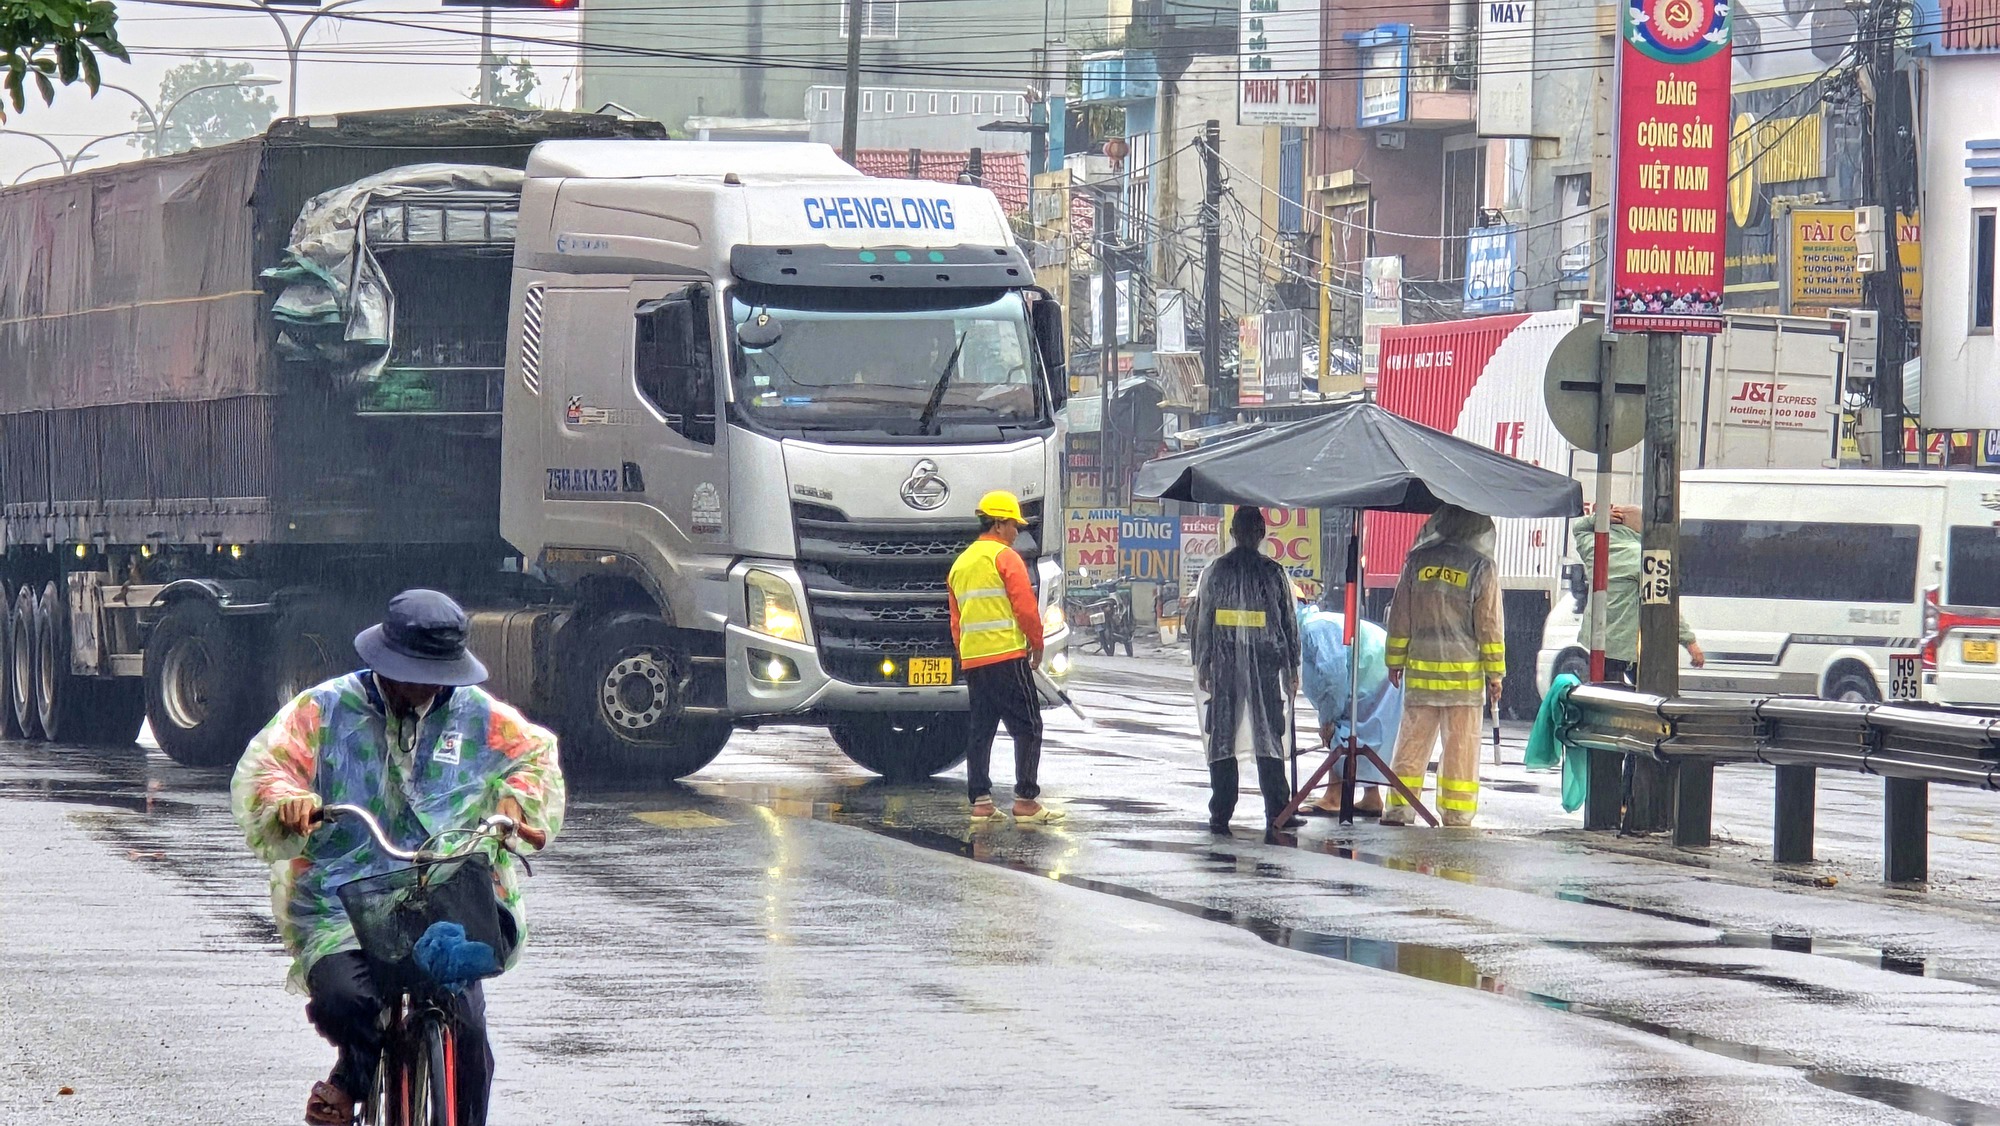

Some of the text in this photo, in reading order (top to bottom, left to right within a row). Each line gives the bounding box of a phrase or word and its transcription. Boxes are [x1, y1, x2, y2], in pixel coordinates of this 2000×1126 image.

[1244, 78, 1279, 104] MINH
[1656, 72, 1697, 106] ĐẢNG
[1637, 115, 1713, 153] CỘNG SẢN
[1639, 159, 1709, 195] VIỆT NAM
[804, 197, 955, 230] CHENGLONG
[1628, 206, 1717, 234] QUANG VINH
[1800, 219, 1835, 242] TÀI
[1626, 244, 1671, 274] MUÔN
[1674, 245, 1715, 276] NĂM!
[1729, 405, 1767, 416] Hotline:
[1794, 410, 1816, 419] 1088
[1777, 395, 1818, 406] EXPRESS
[1122, 517, 1173, 540] DŨNG
[1079, 545, 1117, 566] MÌ
[1644, 556, 1670, 577] CS
[1643, 578, 1669, 600] 19
[922, 659, 940, 672] 75H
[1897, 658, 1915, 678] H9
[1892, 680, 1917, 698] 955
